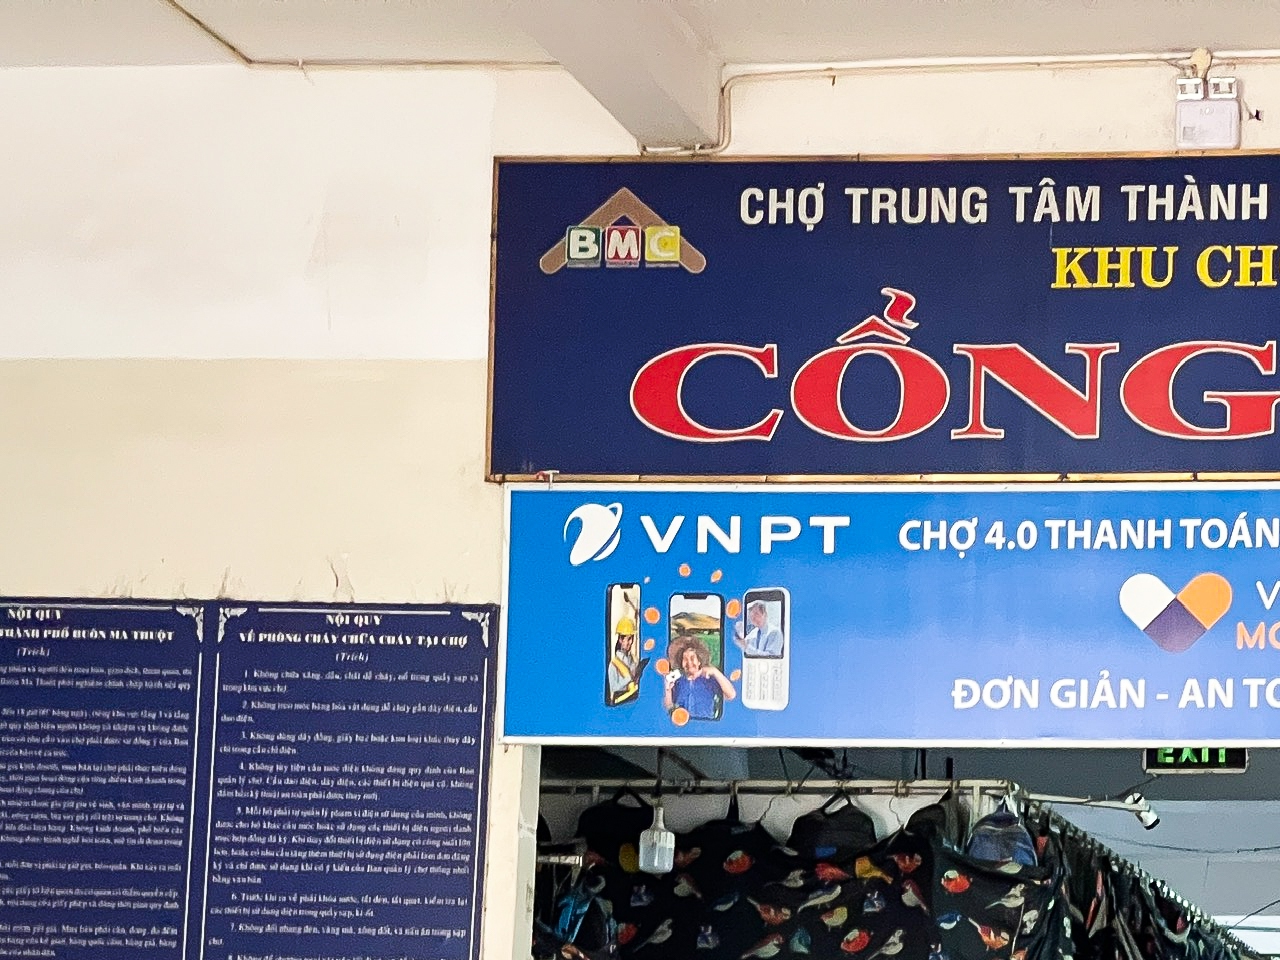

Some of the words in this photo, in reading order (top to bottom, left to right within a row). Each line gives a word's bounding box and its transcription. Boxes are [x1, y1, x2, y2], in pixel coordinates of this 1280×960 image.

[740, 181, 825, 231] CHỢ
[844, 186, 989, 224] TRUNG
[1008, 178, 1101, 223] TÂM
[1121, 174, 1268, 222] THÀNH
[568, 227, 678, 264] BMC
[1051, 246, 1178, 289] KHU
[640, 515, 850, 554] VNPT
[899, 516, 981, 559] CHỢ
[984, 520, 1038, 551] 4.0
[1044, 517, 1171, 550] THANH
[1177, 509, 1280, 549] TOÁN
[44, 627, 70, 638] PHỐ
[72, 628, 106, 639] BUÔN
[110, 630, 128, 639] MA
[132, 629, 174, 642] THUỘT
[239, 629, 255, 641] VỀ
[258, 631, 301, 642] PHÒNG
[304, 632, 338, 643] CHÁY
[341, 631, 375, 645] CHỮA
[378, 633, 412, 645] CHÁY
[417, 635, 438, 647] TẠI
[441, 635, 467, 648] CHỢ
[325, 612, 350, 626] NỘI
[353, 614, 382, 627] QUY
[952, 676, 1043, 710] ĐƠN
[1048, 669, 1147, 711] GIẢN
[1178, 678, 1234, 708] AN
